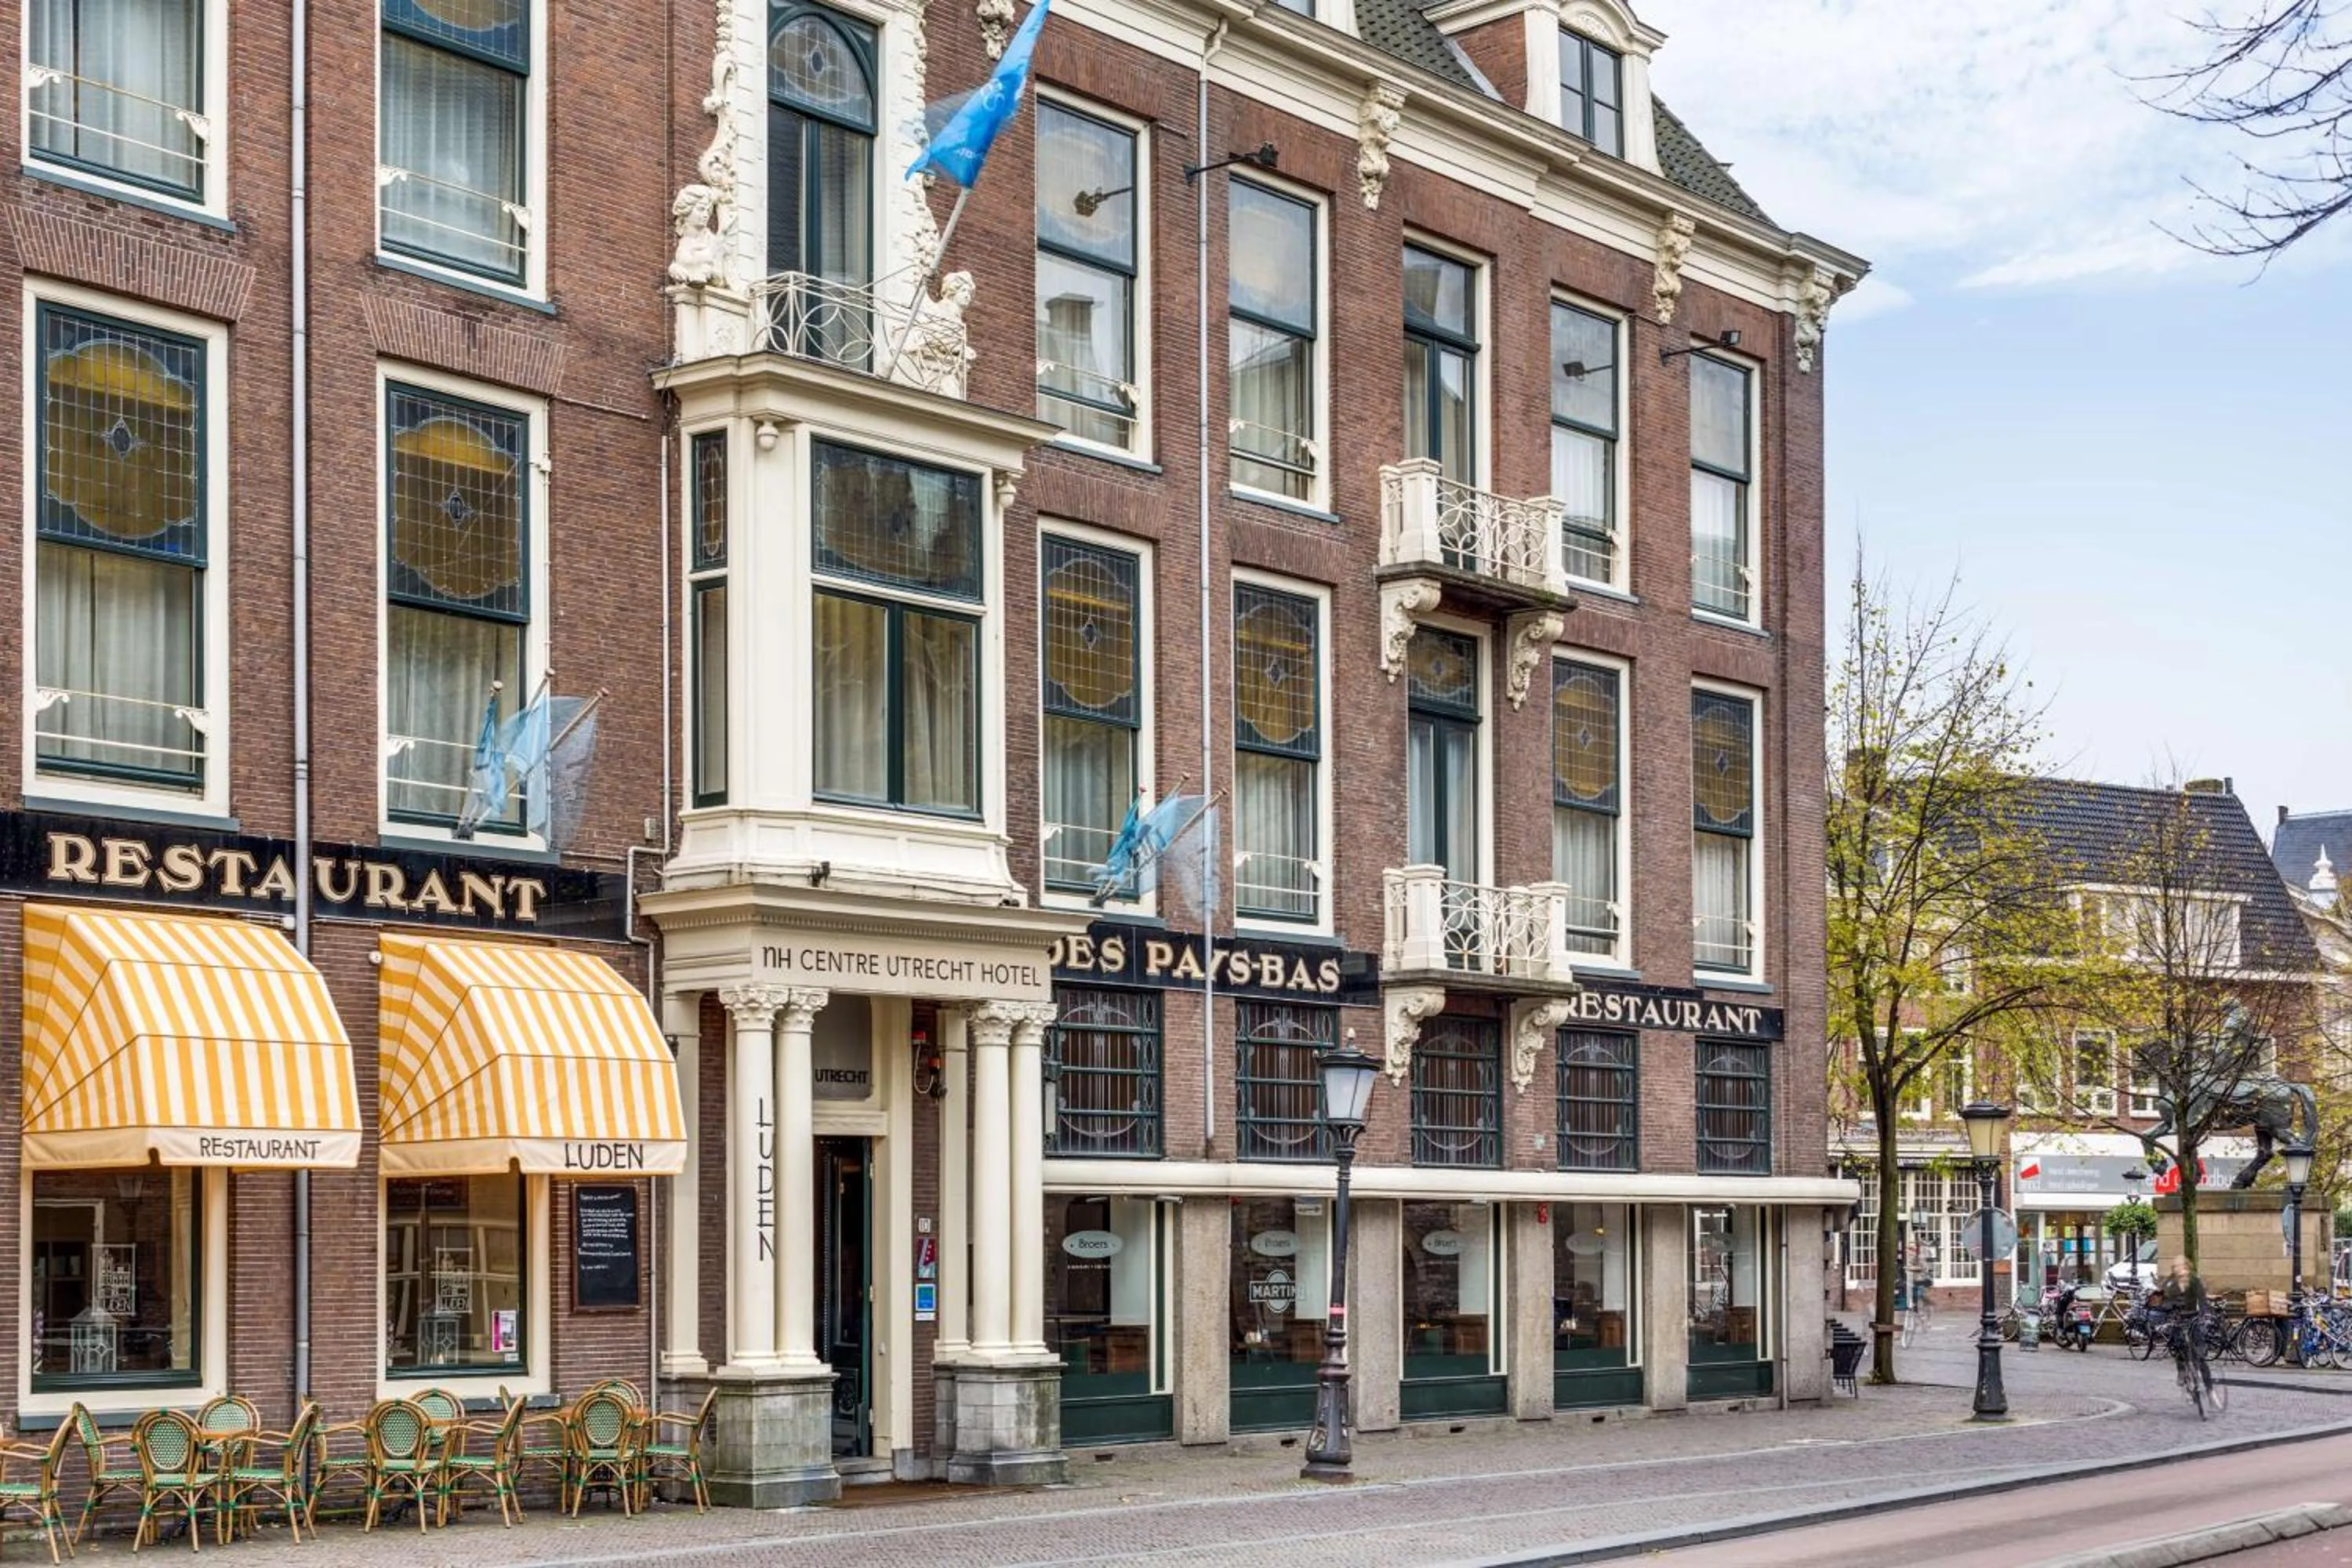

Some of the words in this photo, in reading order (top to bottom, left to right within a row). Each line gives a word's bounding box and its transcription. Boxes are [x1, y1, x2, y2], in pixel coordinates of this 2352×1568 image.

[47, 832, 547, 922] RESTAURANT
[800, 949, 880, 975] CENTRE
[887, 956, 975, 982] UTRECHT
[981, 963, 1042, 987] HOTEL
[815, 1069, 868, 1083] UTRECHT
[200, 1138, 321, 1160] RESTAURANT
[564, 1142, 643, 1170] LUDEN
[756, 1098, 775, 1261] LUDEN
